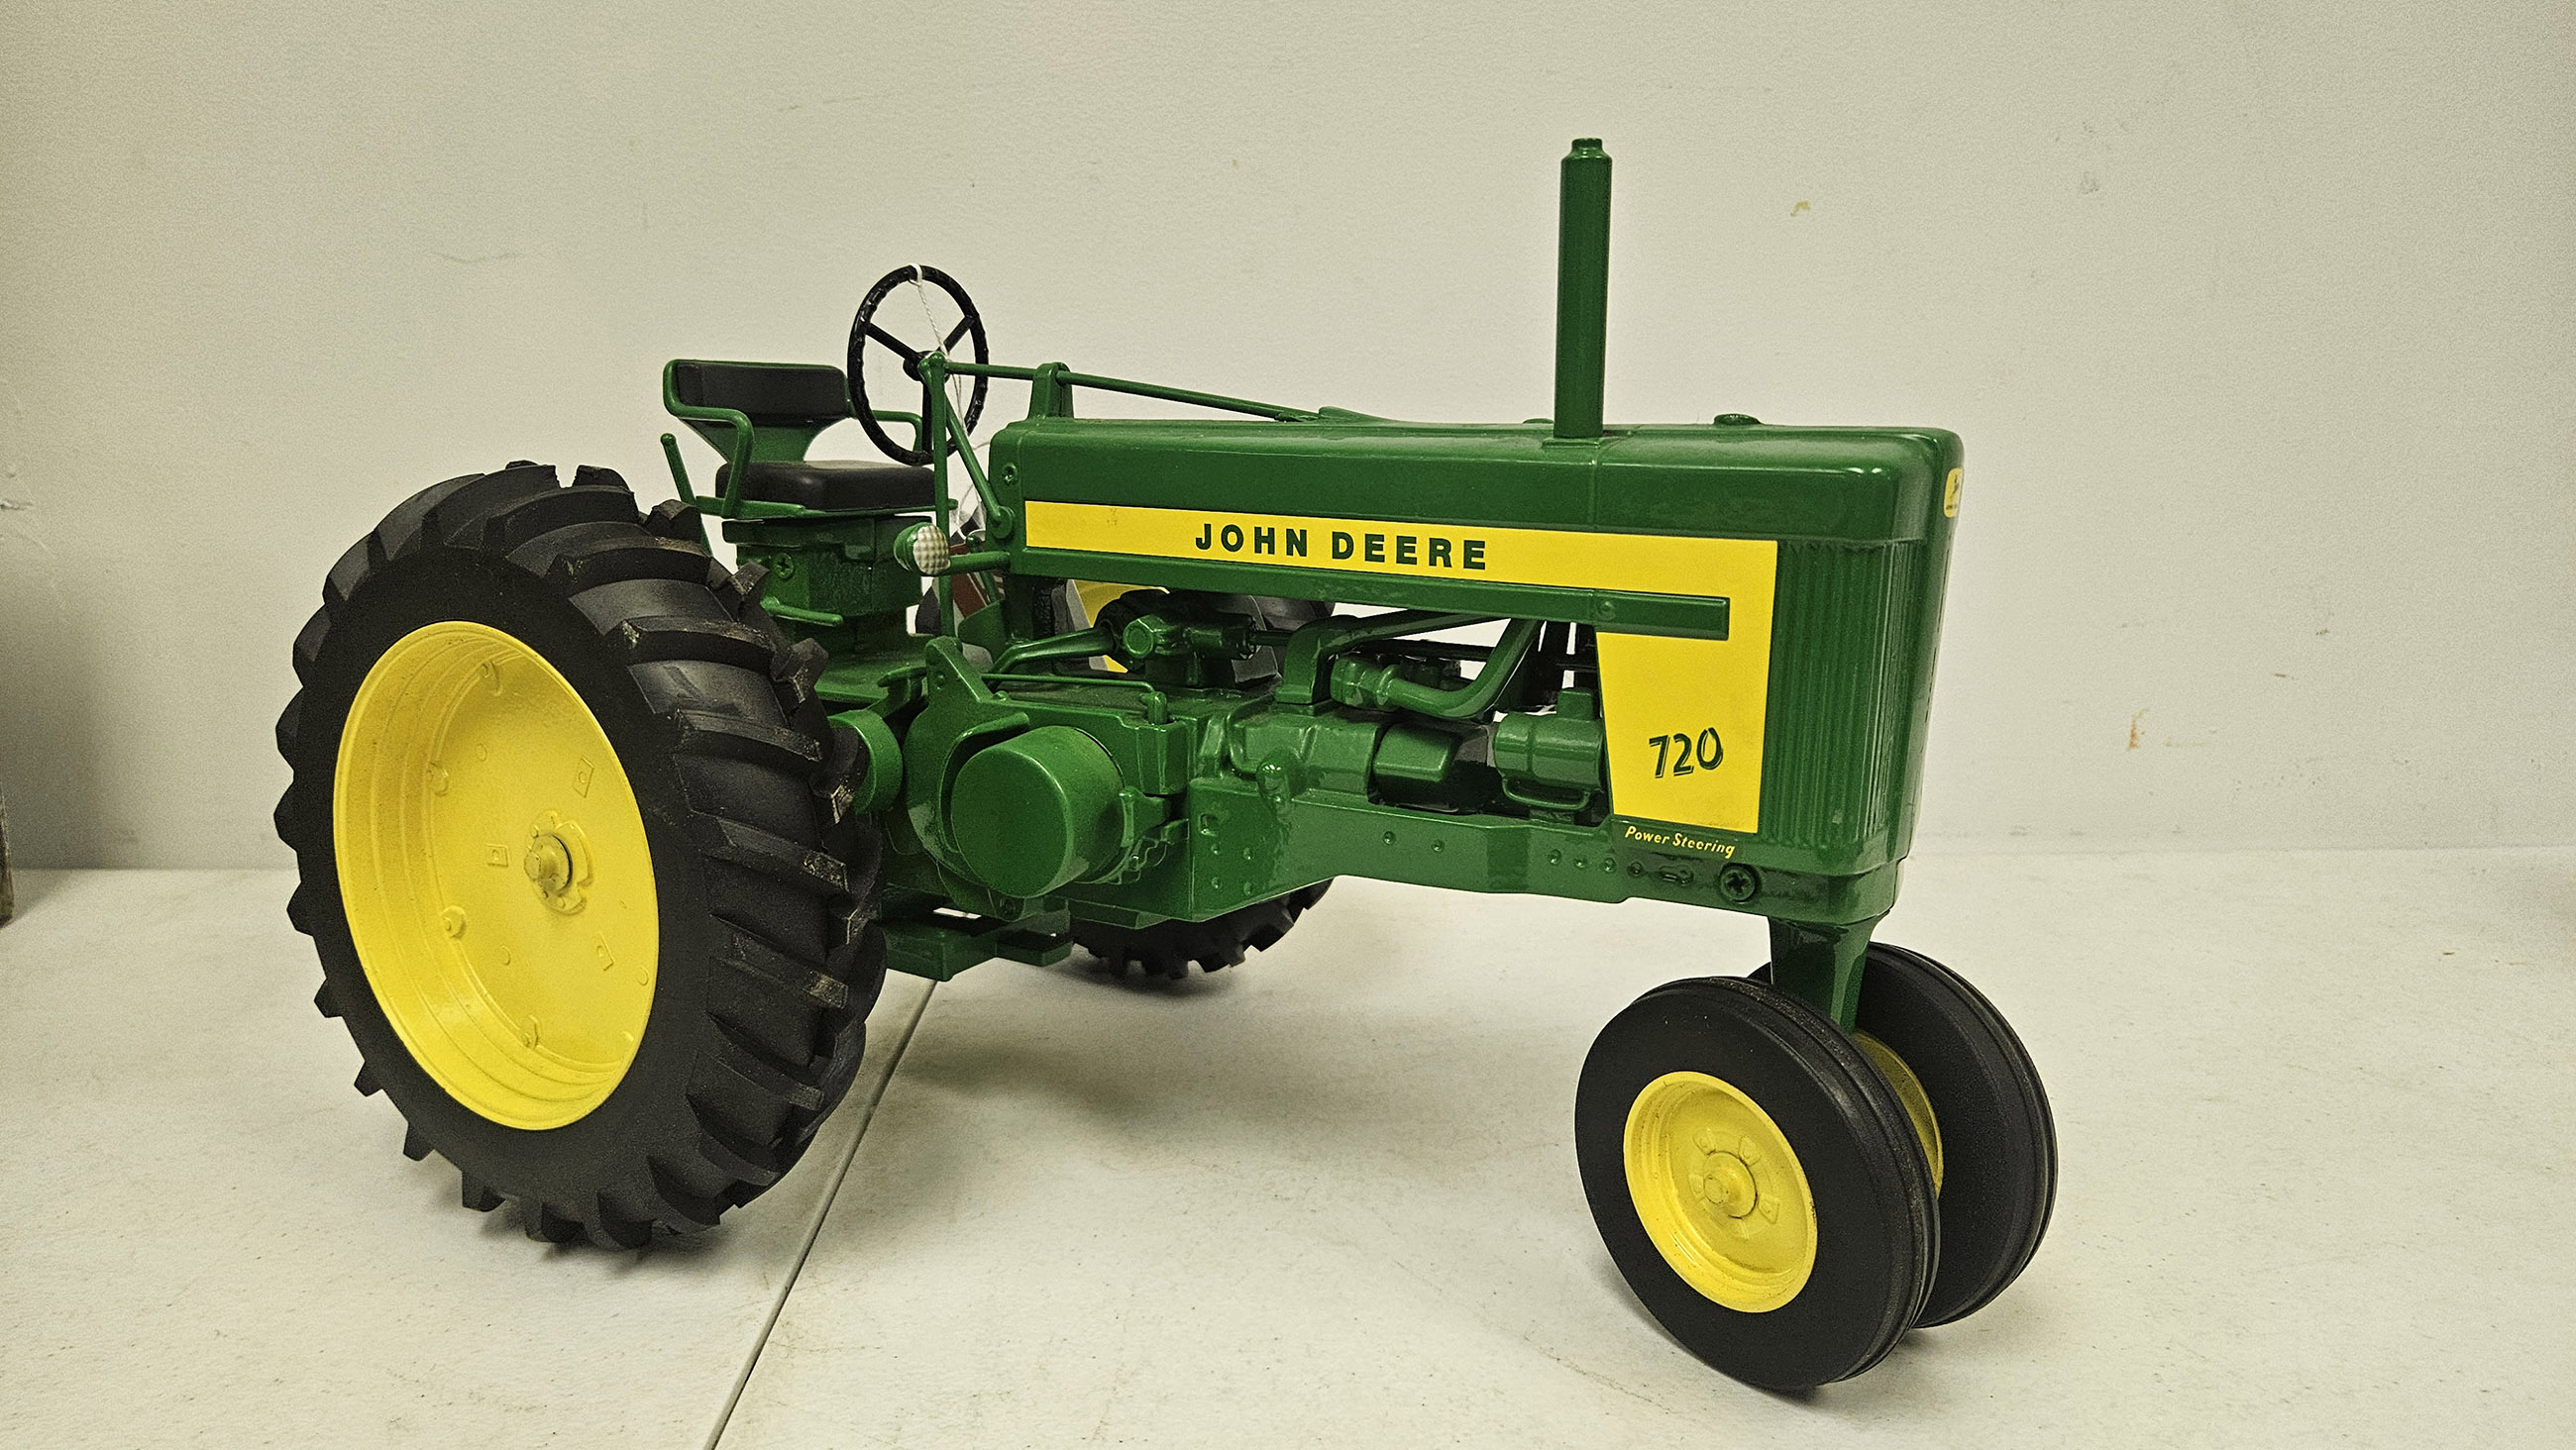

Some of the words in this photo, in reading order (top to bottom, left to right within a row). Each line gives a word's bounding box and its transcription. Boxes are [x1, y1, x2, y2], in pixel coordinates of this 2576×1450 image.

[1195, 523, 1308, 558] JOHN
[1332, 531, 1486, 570] DEERE
[1649, 727, 1724, 778] 720
[1625, 825, 1669, 845] Power
[1672, 833, 1736, 859] Steering
